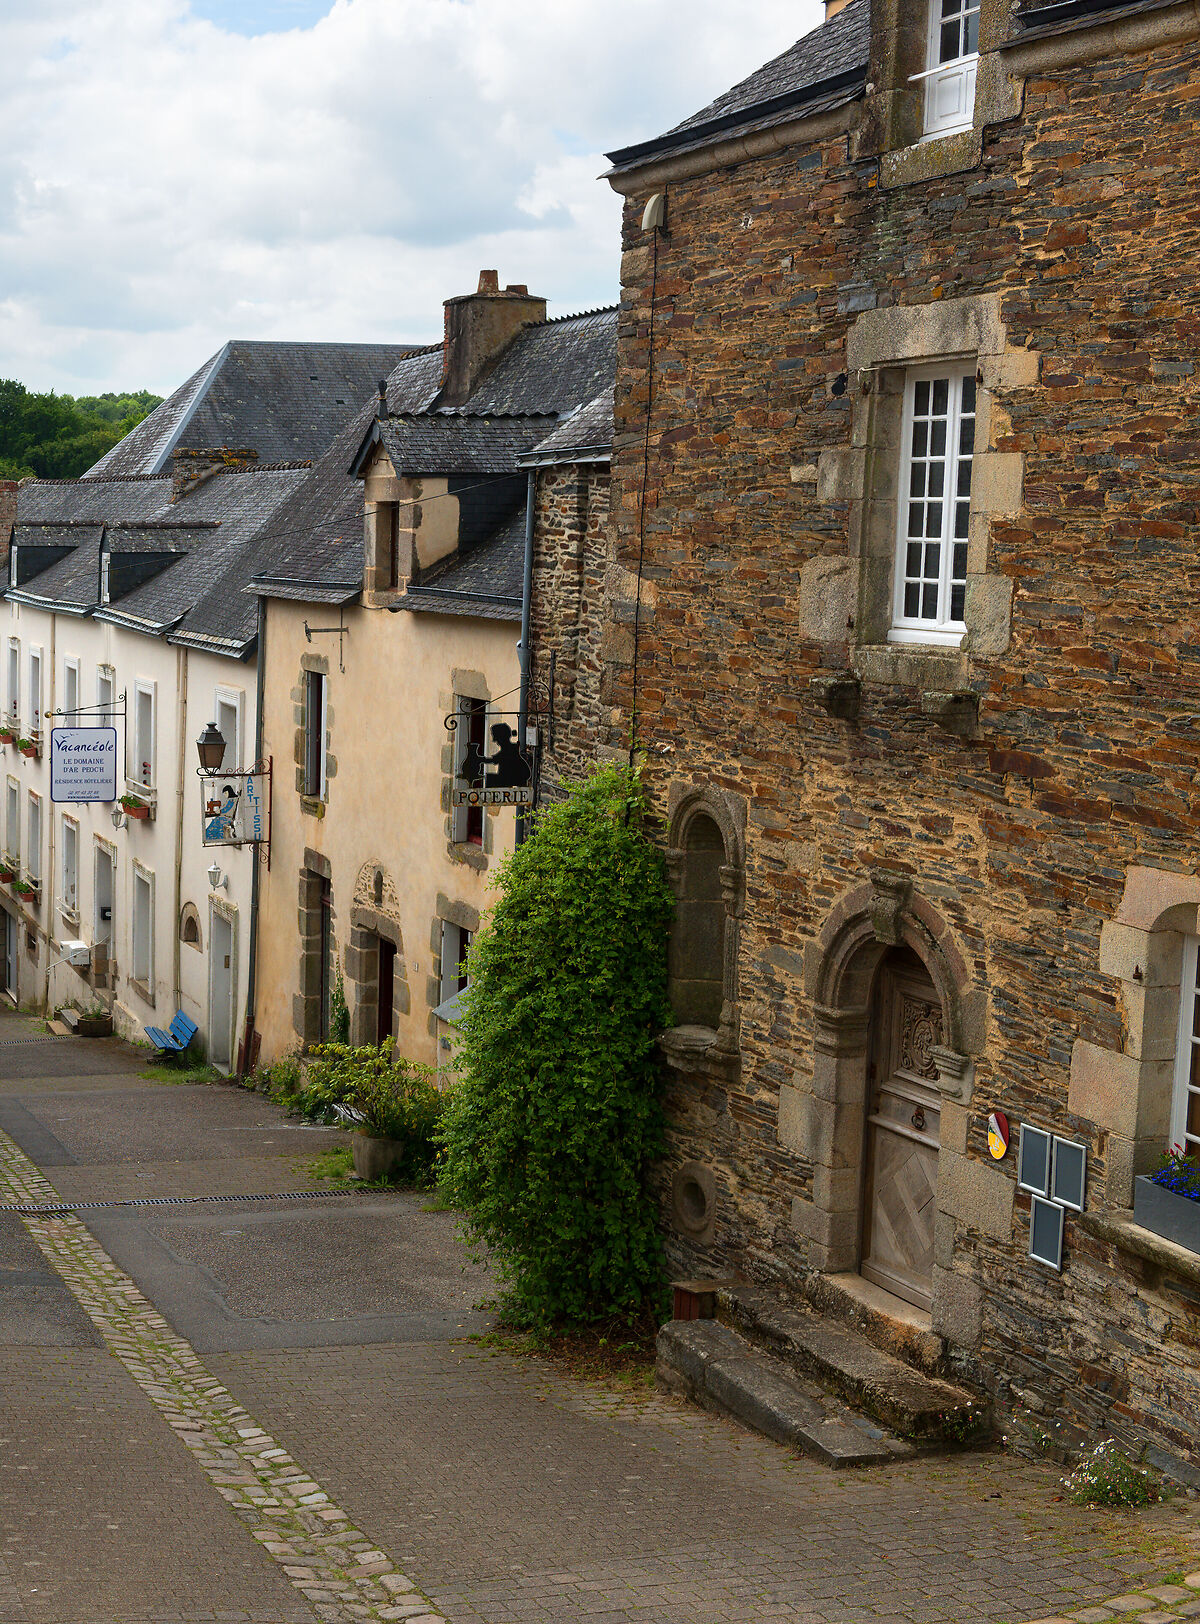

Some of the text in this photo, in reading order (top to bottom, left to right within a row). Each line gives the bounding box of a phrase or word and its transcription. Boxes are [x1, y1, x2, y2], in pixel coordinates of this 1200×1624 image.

[54, 738, 113, 752] Vacancéole
[458, 790, 529, 803] POTERIE
[253, 796, 261, 840] TISSU
